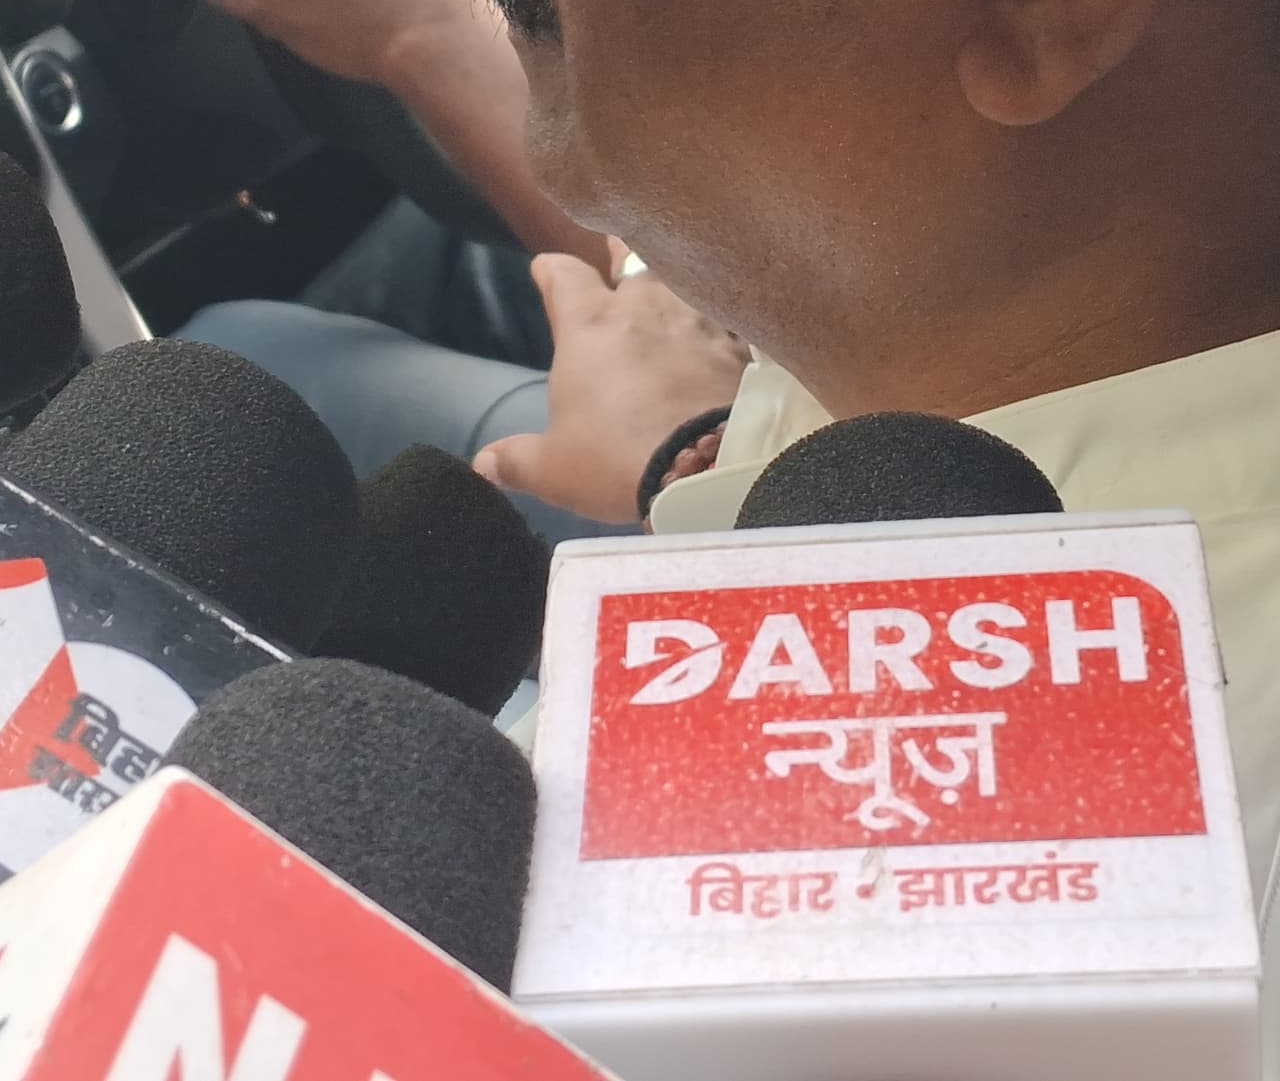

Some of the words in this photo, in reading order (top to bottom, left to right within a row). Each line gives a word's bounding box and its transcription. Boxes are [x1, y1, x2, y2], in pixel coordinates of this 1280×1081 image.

[625, 596, 1150, 705] DARSH
[762, 712, 1007, 832] न्यूज़
[686, 863, 838, 917] बिहार
[894, 850, 1100, 912] झारखंड
